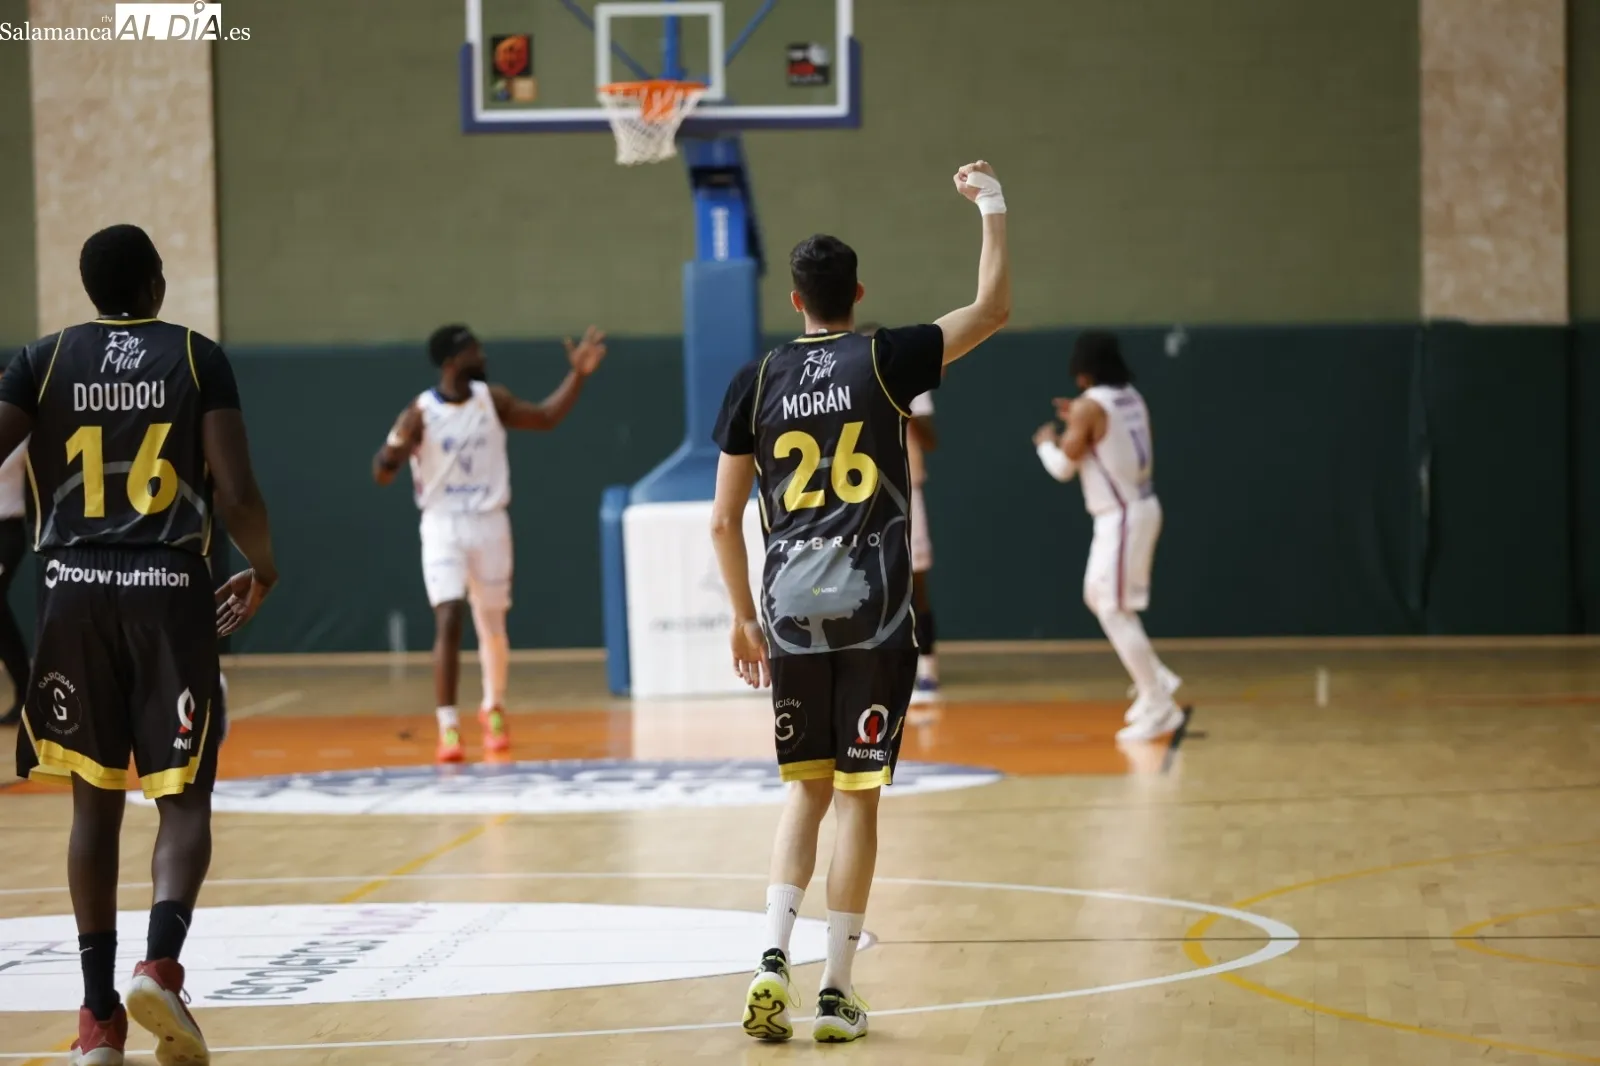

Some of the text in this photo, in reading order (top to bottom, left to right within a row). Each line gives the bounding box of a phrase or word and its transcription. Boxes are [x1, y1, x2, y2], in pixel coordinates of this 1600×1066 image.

[73, 380, 166, 412] DOUDOU
[782, 383, 852, 420] MORÁN
[65, 422, 179, 519] 16
[773, 420, 878, 513] 26
[59, 563, 114, 585] trouw
